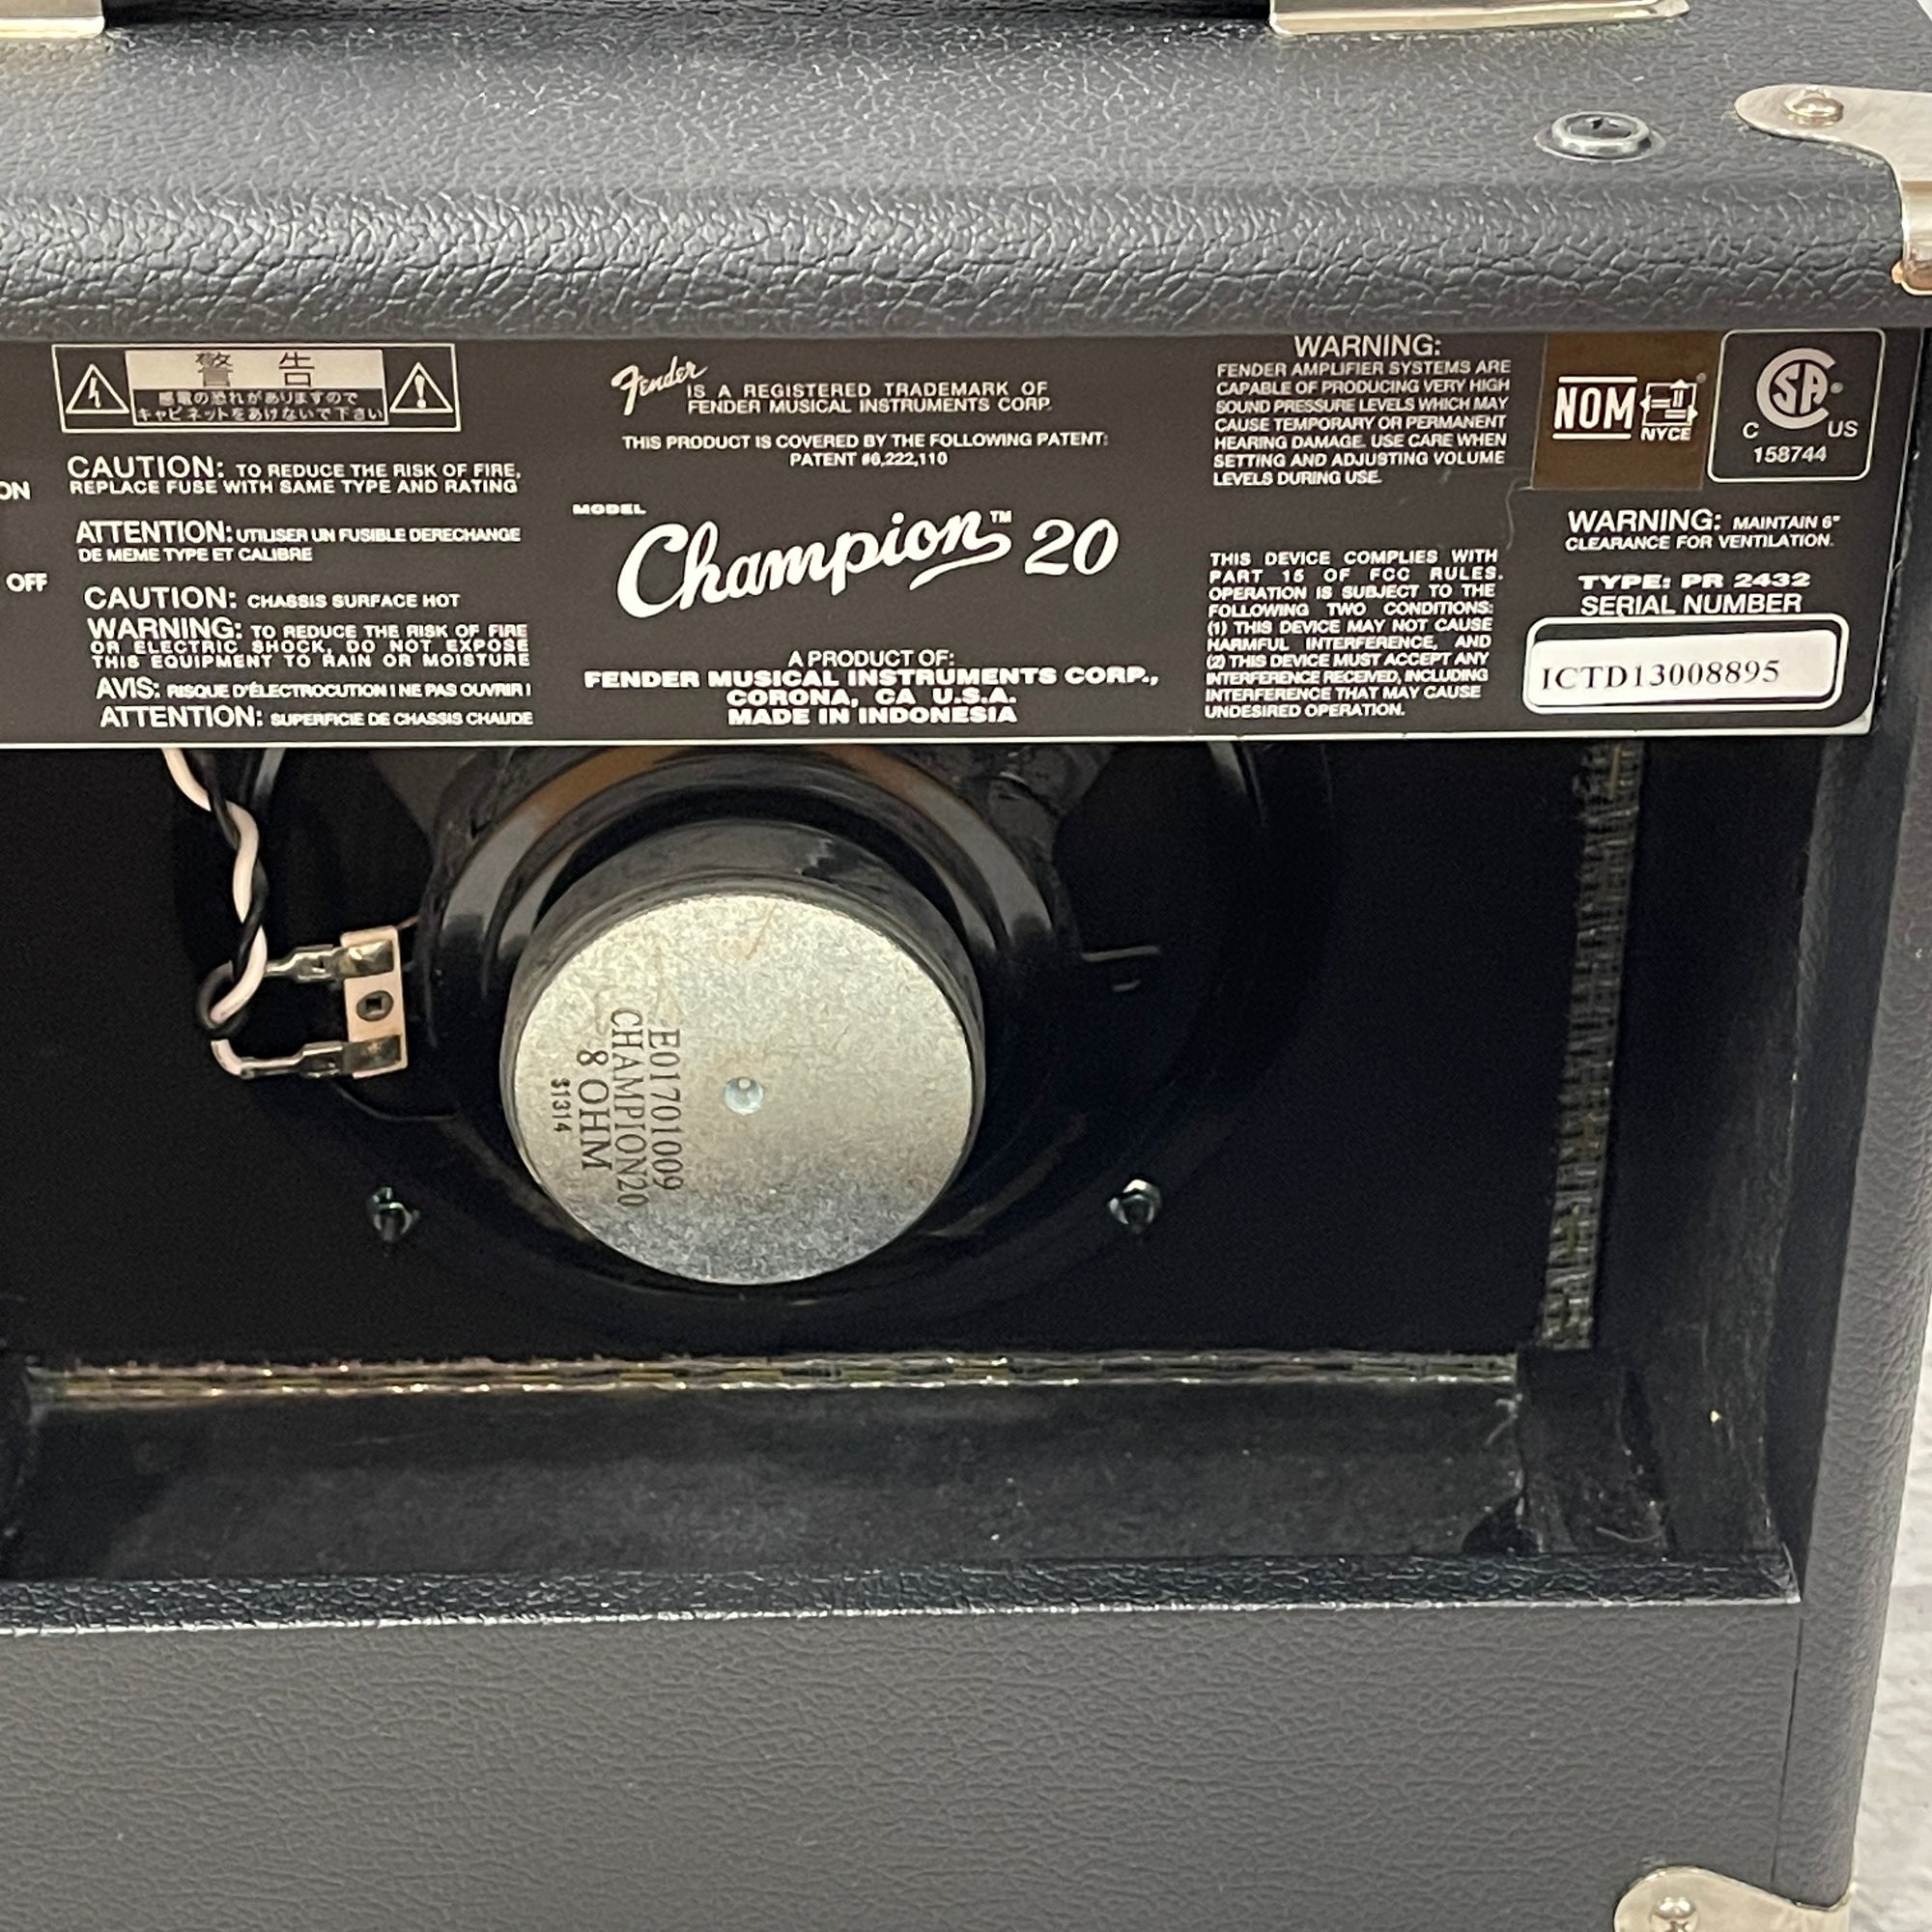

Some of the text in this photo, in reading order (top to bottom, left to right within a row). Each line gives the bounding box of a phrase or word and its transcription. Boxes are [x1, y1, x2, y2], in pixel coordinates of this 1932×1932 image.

[1293, 334, 1441, 357] WARNING:
[1217, 359, 1510, 377] FENDER AMPLIFIER SYSTEMS ARE
[611, 355, 1047, 415] Fender IS A REGISTERED TRADEMARK OF
[1216, 378, 1509, 395] CAPABLE OF PRODUCING VERY HIGH
[688, 400, 760, 413] FENDER
[769, 399, 852, 413] MUSICAL
[860, 398, 989, 412] INSTRUMENTS
[1553, 386, 1635, 429] NOM
[1215, 414, 1506, 432] CAUSE TEMPORARY OR PERMANENT
[1828, 420, 1858, 437] US
[622, 436, 661, 449] THIS
[666, 435, 751, 449] PRODUCT
[755, 435, 771, 448] IS
[775, 434, 859, 448] COVERED
[863, 434, 887, 447] BY
[891, 434, 925, 447] THE
[929, 433, 1032, 447] FOLLOWING
[1640, 428, 1690, 440] NYCE
[790, 453, 857, 466] PATENT
[1753, 445, 1826, 463] 158744
[67, 455, 521, 477] CAUTION: TO REDUCE THE RISK OF FIRE,
[70, 480, 159, 494] REPLACE
[166, 480, 217, 494] FUSE
[222, 480, 272, 493] WITH
[279, 479, 335, 493] SAME
[340, 479, 391, 493] TYPE
[397, 479, 438, 493] AND
[1212, 471, 1273, 485] LEVELS
[1277, 470, 1341, 484] DURING
[1568, 509, 1721, 532] WARNING:
[1733, 515, 1818, 529] MAINTAIN
[75, 520, 233, 543] ATTENTION:
[236, 527, 307, 542] UTILISER
[311, 528, 334, 542] UN
[339, 527, 406, 542] FUSIBLE
[1565, 535, 1670, 551] CLEARANCE
[1676, 535, 1713, 549] FOR
[78, 547, 312, 561] DE MEME TYPE ET CALIBRE
[1209, 550, 1497, 566] THIS DEVICE COMPLIES WITH
[616, 510, 1011, 618] Champion
[1024, 518, 1119, 576] 20
[7, 573, 47, 591] OFF
[1209, 566, 1503, 583] PART 15 OF FCC RULES.
[1577, 573, 1810, 589] TYPE: PR 2432
[84, 586, 459, 609] CAUTION: CHASSIS SURFACE HOT
[1208, 583, 1495, 600] OPERATION IS SUBJECT TO THE
[1208, 603, 1309, 617] FOLLOWING
[1326, 602, 1366, 615] TWO
[1580, 593, 1802, 616] SERIAL NUMBER
[86, 617, 527, 639] WARNING: TO REDUCE THE RISK OF FIRE
[90, 639, 528, 654] OR ELECTRIC SHOCK, DO NOT EXPOSE
[788, 649, 954, 667] A PRODUCT OF:
[583, 668, 1158, 688] FENDER MUSICAL INSTRUMENTS CORP.,
[1543, 661, 1778, 689] ICTD13008895
[97, 677, 160, 698] AVIS:
[399, 683, 422, 696] NE
[424, 683, 457, 696] PAS
[460, 683, 523, 696] OUVRIR
[726, 688, 1016, 707] CORONA, CA U.S.A.
[99, 705, 533, 727] ATTENTION: SUPERFICIE DE CHASSIS CHAUDE
[728, 706, 1016, 724] MADE IN INDONESIA
[577, 1050, 612, 1171] 8 OHM
[611, 1007, 649, 1207] CHAMPION20
[648, 1029, 684, 1190] E01701009
